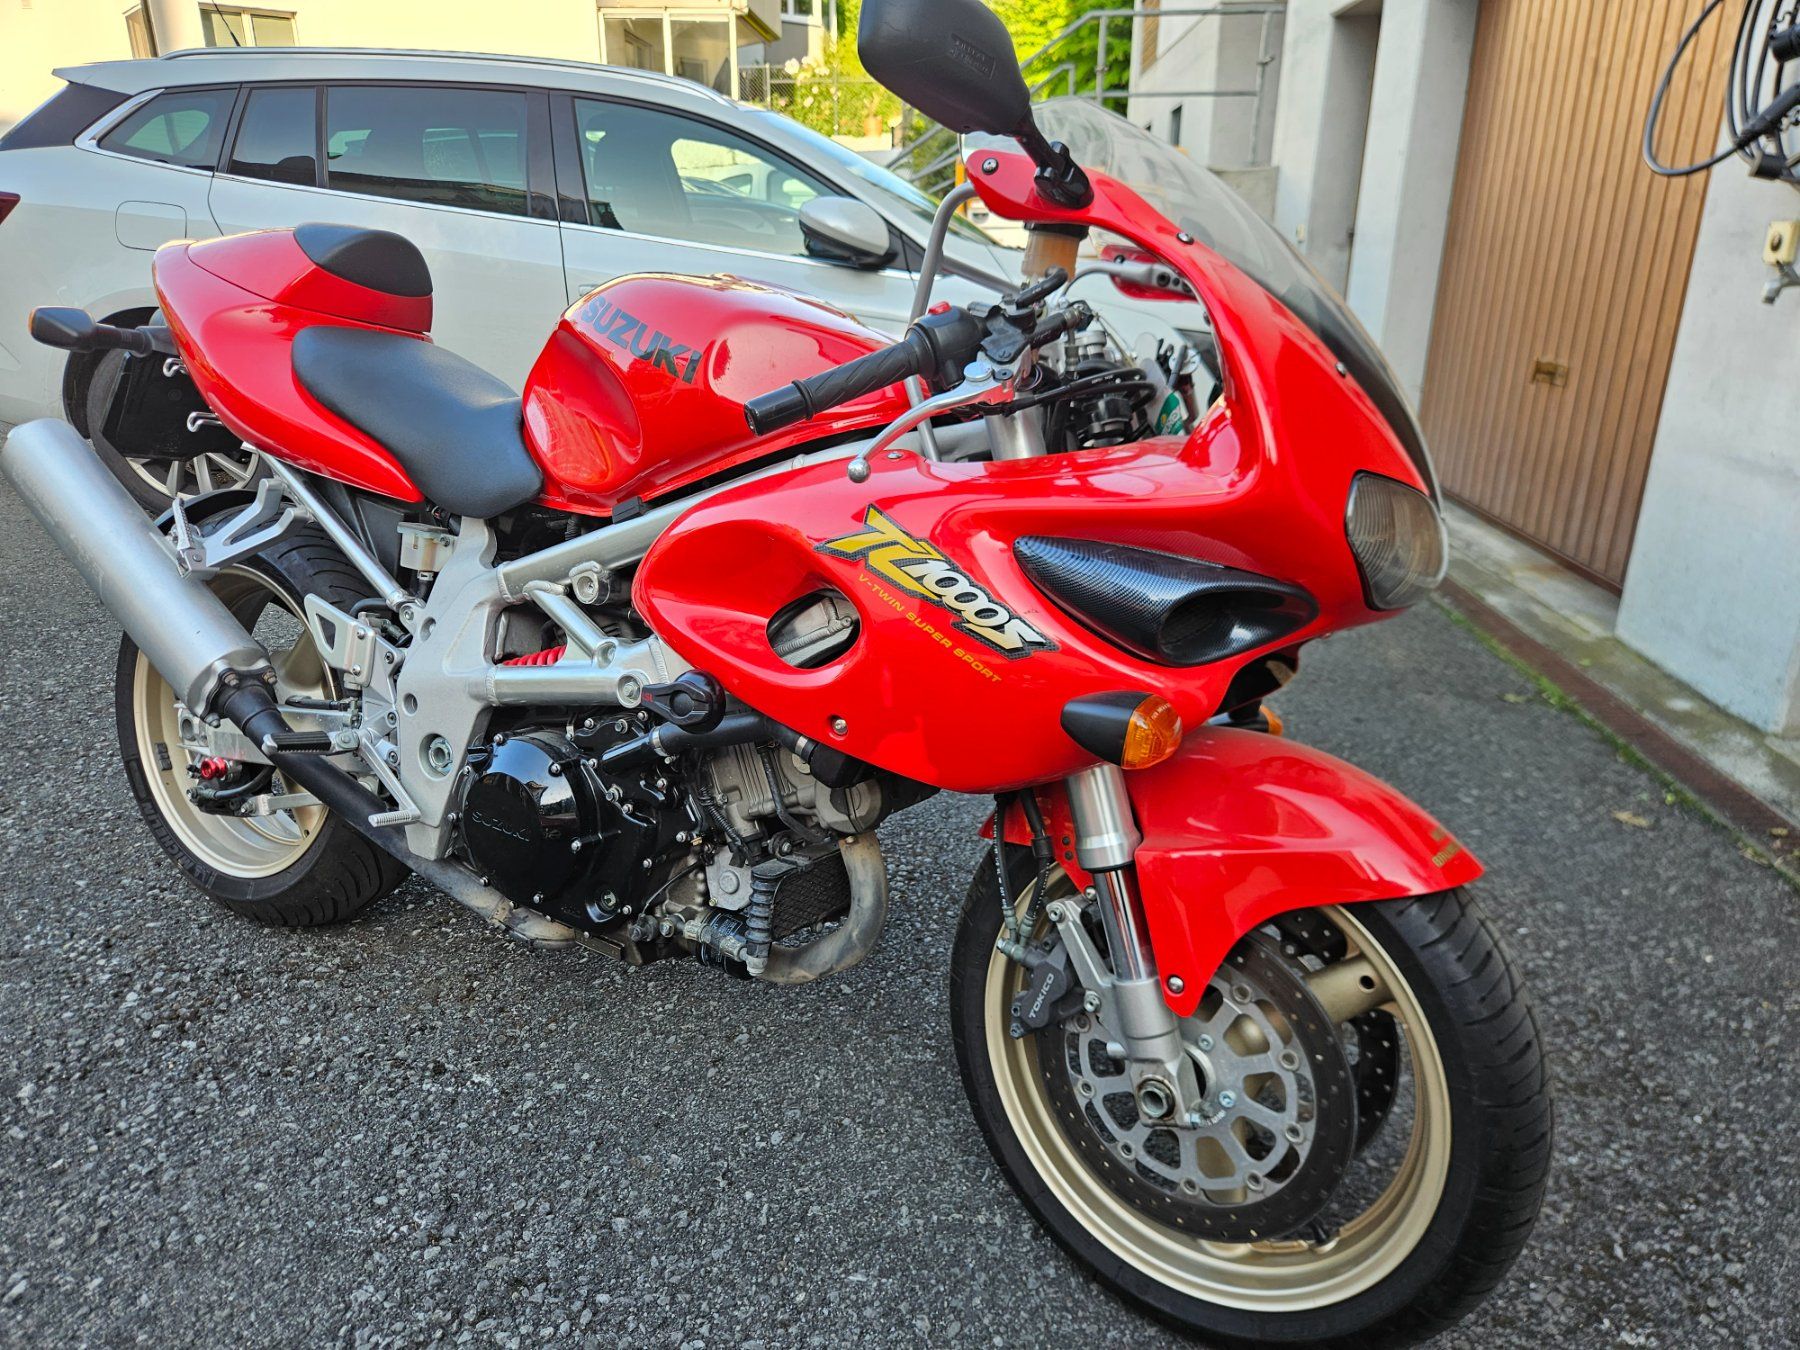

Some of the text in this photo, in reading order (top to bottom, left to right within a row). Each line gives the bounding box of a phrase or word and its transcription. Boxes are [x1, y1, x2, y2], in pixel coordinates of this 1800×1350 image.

[580, 295, 703, 384] SUZUKI
[857, 573, 1003, 683] V-TWIN SUPER SPORT
[140, 801, 195, 870] MICHELIN
[1028, 972, 1055, 1018] TOKICO
